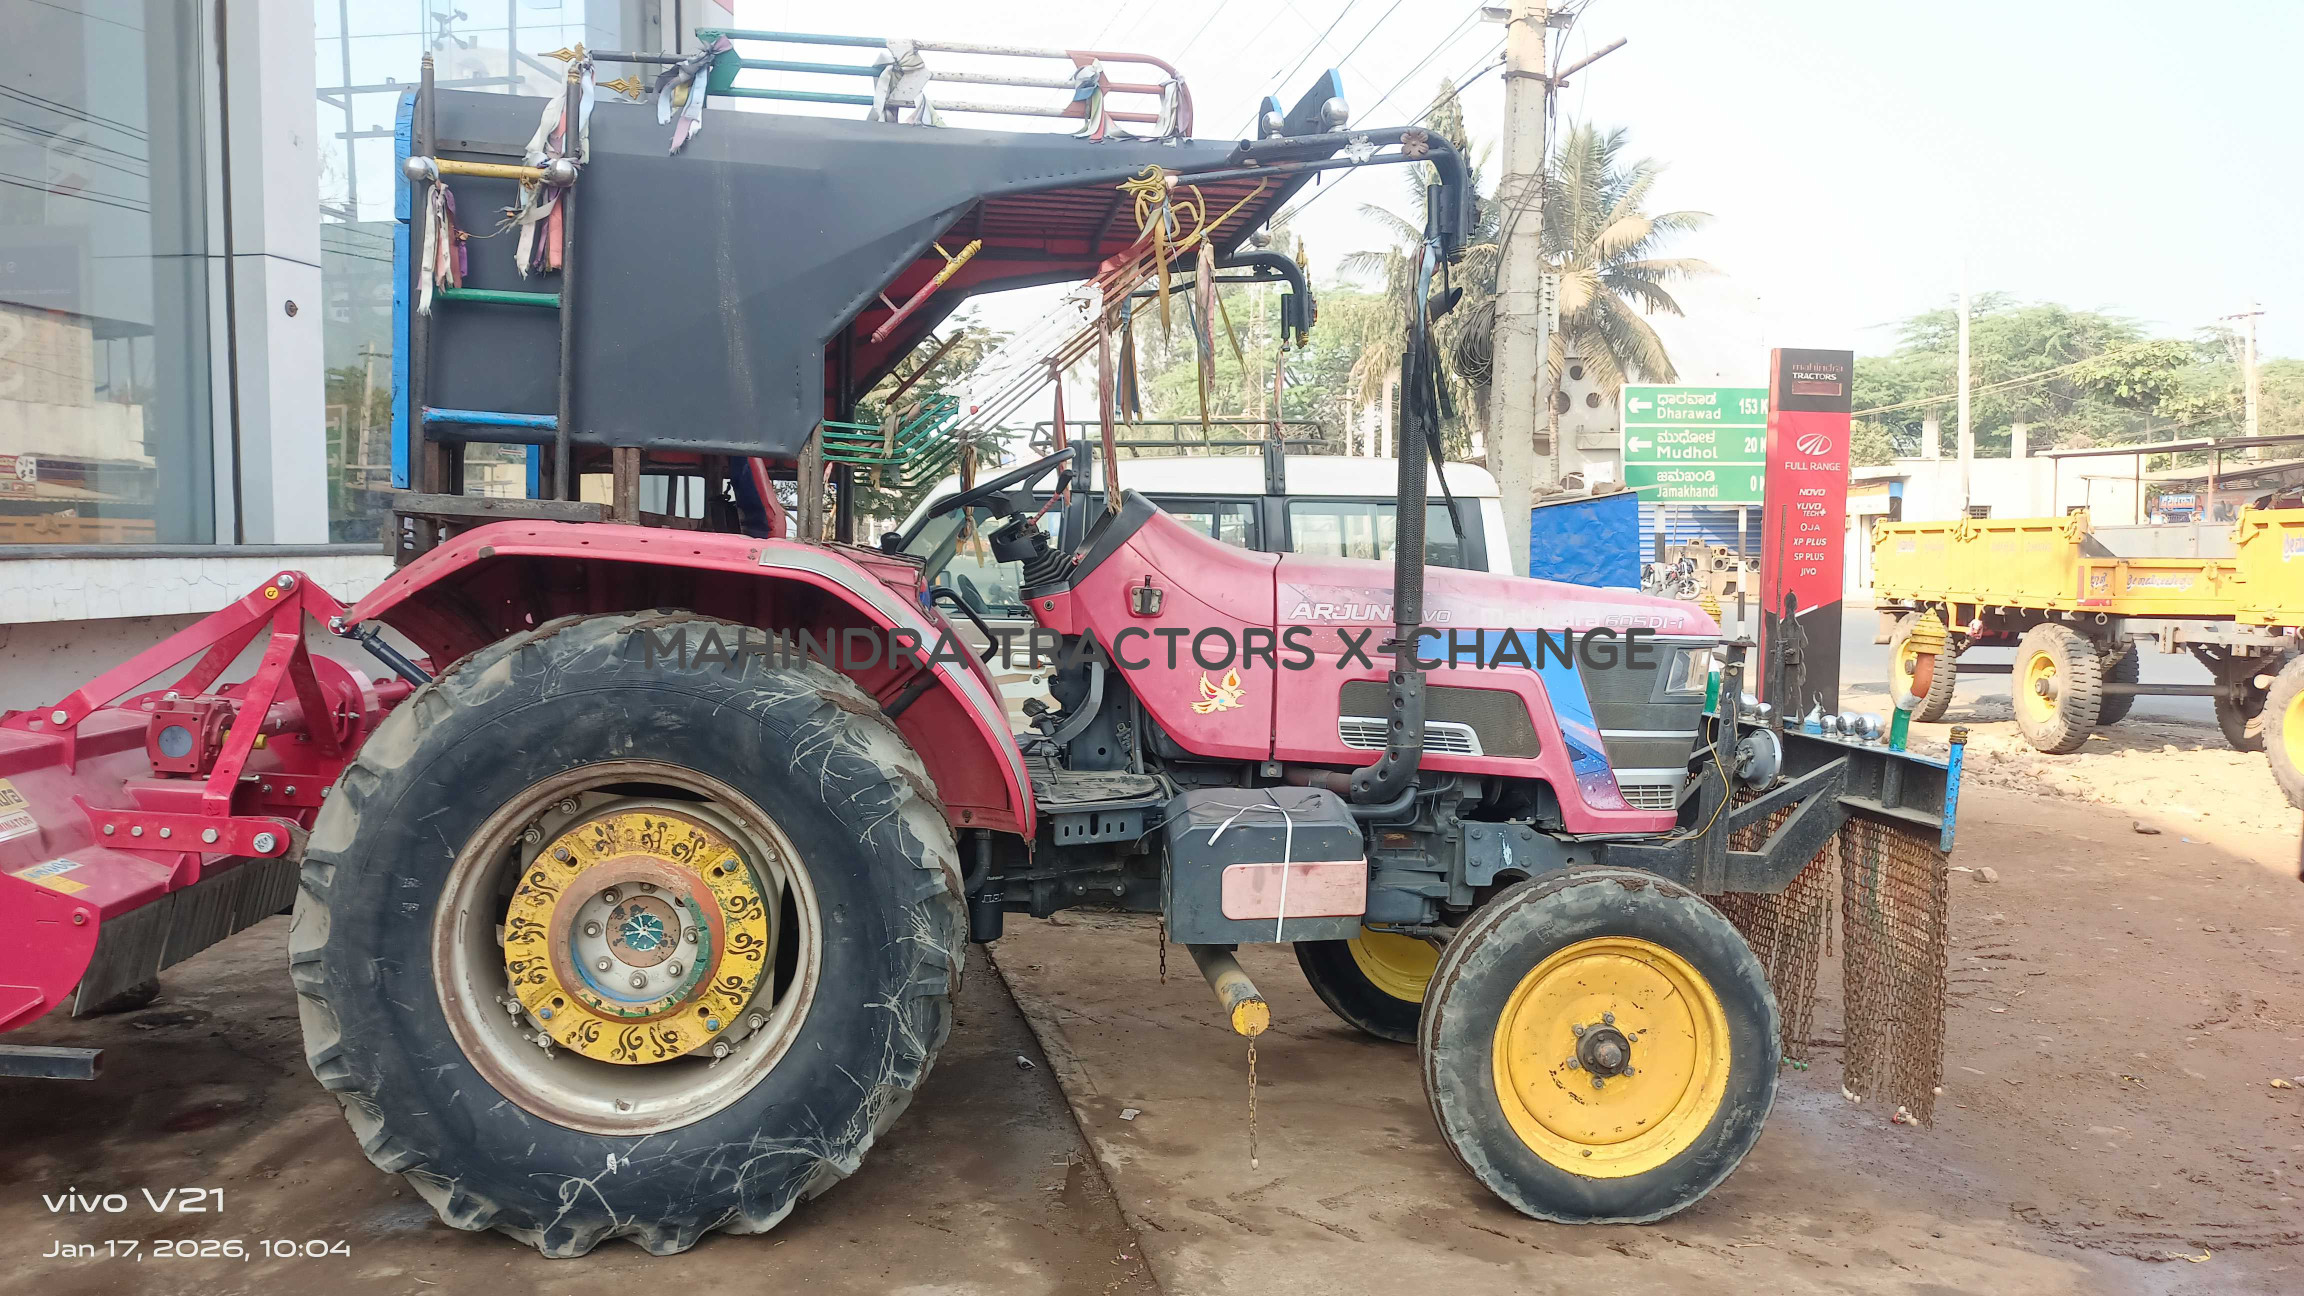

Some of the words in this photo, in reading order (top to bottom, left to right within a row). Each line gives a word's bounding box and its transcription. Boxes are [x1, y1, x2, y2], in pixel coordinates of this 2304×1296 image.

[1792, 363, 1844, 373] mahindra
[1792, 372, 1837, 381] TRACTORS
[1657, 392, 1717, 406] ಧಾರವಾಡ
[1739, 398, 1759, 415] 153
[1656, 407, 1721, 420] Dharawad
[1744, 437, 1758, 453] 20
[1656, 446, 1718, 459] Mudhol
[1784, 461, 1808, 471] FULL
[1809, 462, 1841, 471] RANGE
[1656, 468, 1716, 482] ಜಮಖಂಡಿ
[1750, 476, 1757, 492] 0
[1656, 484, 1718, 498] Jamakhandi
[1798, 488, 1826, 496] NOVO
[1796, 502, 1822, 510] YUVO
[1800, 523, 1821, 532] OJA
[1793, 538, 1804, 546] XP
[1805, 538, 1827, 546] PLUS
[1793, 552, 1804, 561] SP
[1805, 553, 1825, 561] PLUS
[1800, 567, 1817, 577] JIVO
[1289, 602, 1391, 621] ARJUN
[1423, 609, 1453, 623] VO
